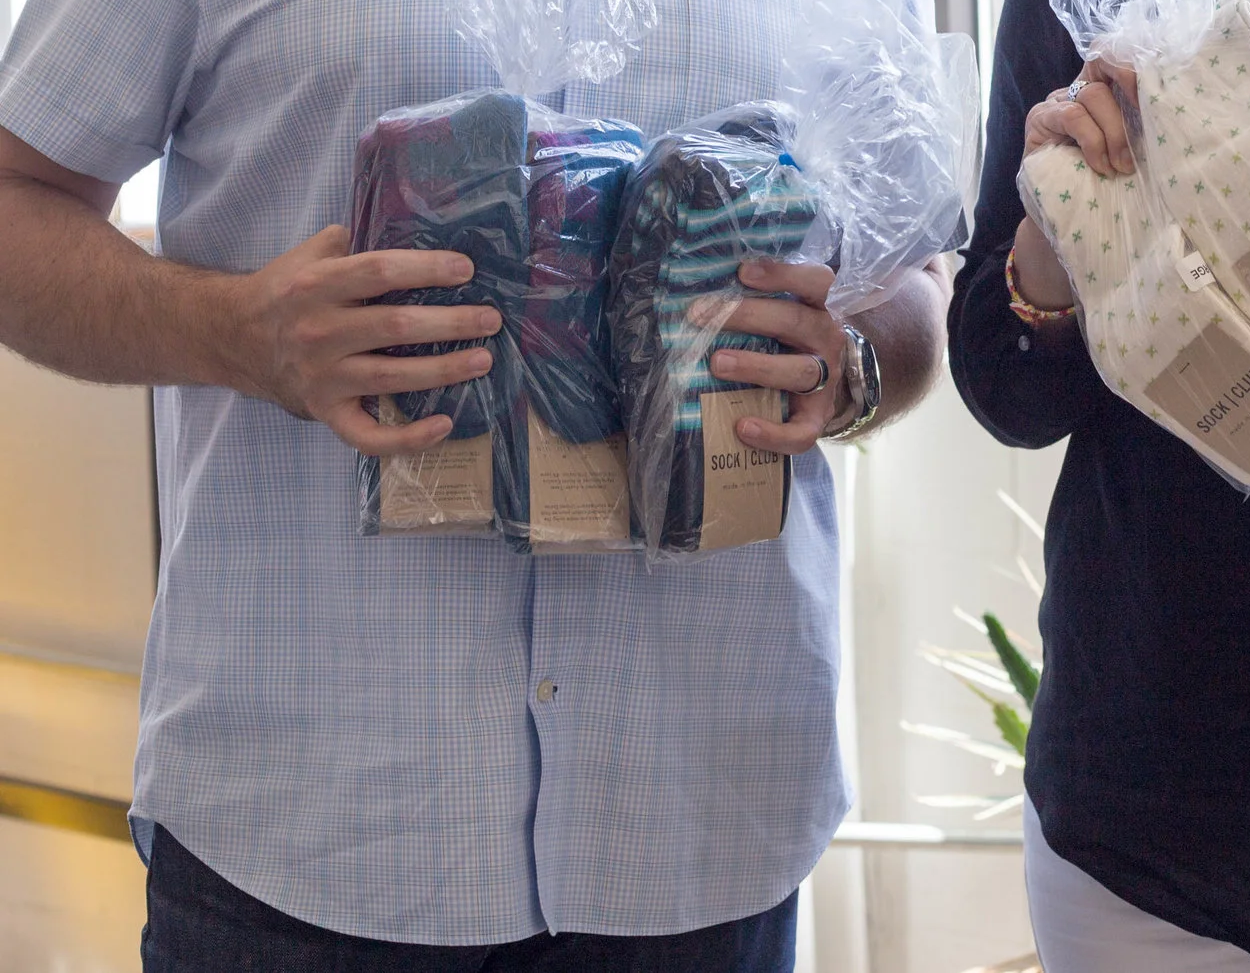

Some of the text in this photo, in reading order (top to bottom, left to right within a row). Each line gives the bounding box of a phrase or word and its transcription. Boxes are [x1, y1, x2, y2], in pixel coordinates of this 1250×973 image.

[1196, 401, 1231, 433] SOCK
[711, 452, 741, 471] SOCK
[750, 450, 779, 467] CLUB
